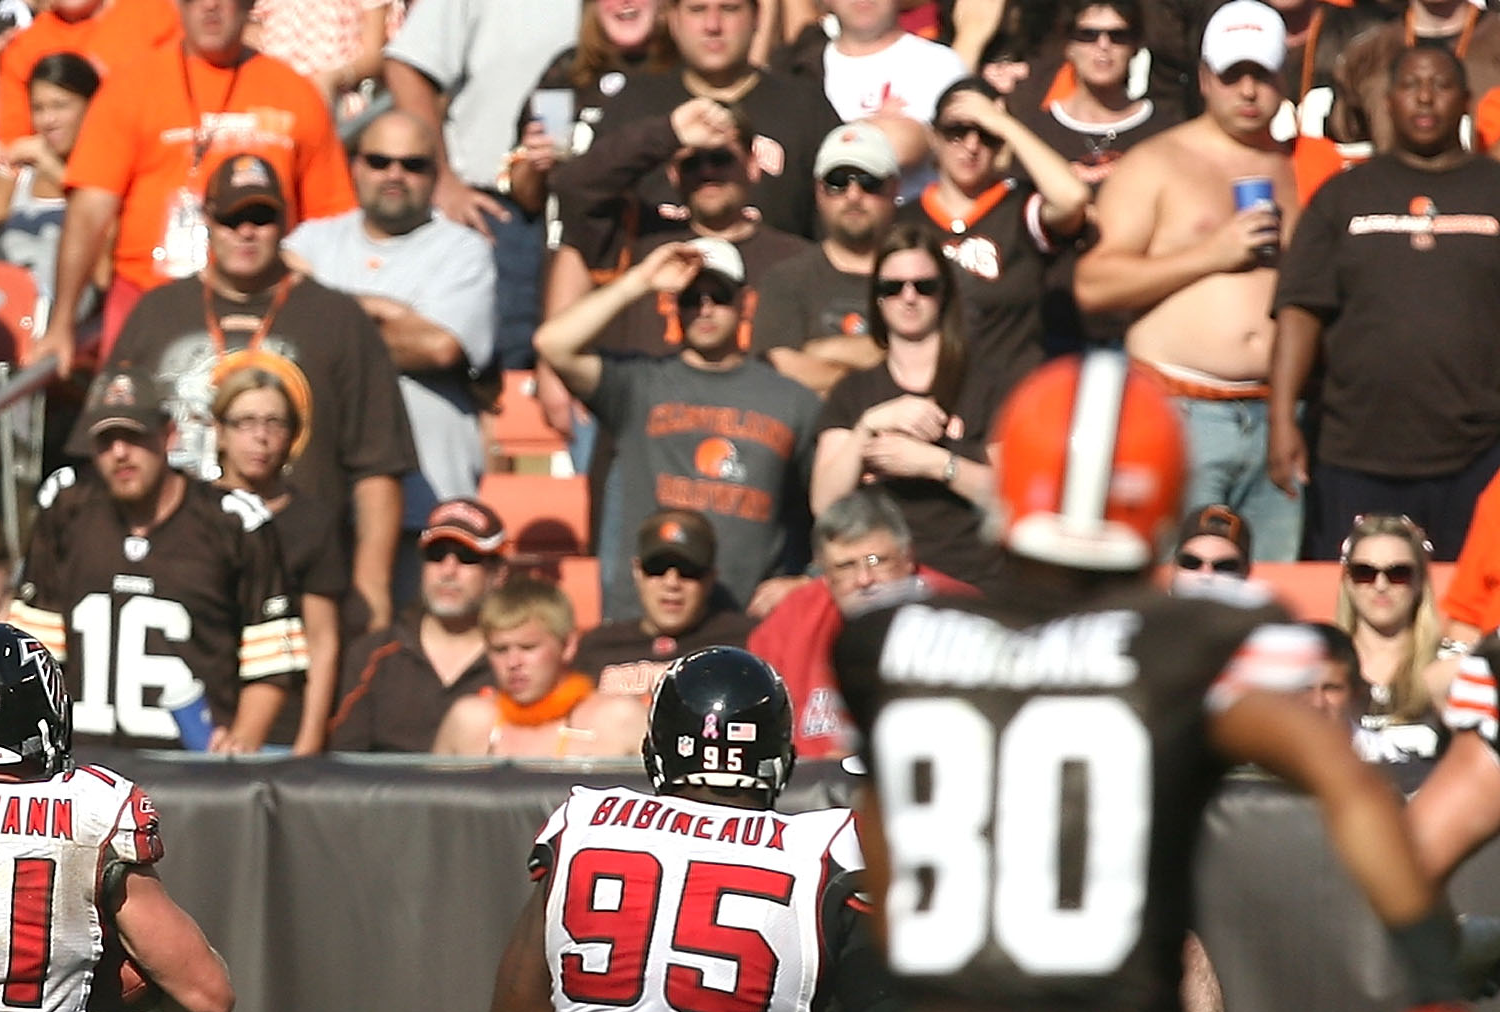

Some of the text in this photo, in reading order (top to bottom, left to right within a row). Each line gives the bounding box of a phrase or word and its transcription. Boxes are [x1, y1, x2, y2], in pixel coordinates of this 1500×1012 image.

[71, 592, 192, 739] 16
[702, 745, 743, 771] 95
[589, 796, 787, 851] BABINEAUX
[872, 695, 1153, 975] 80
